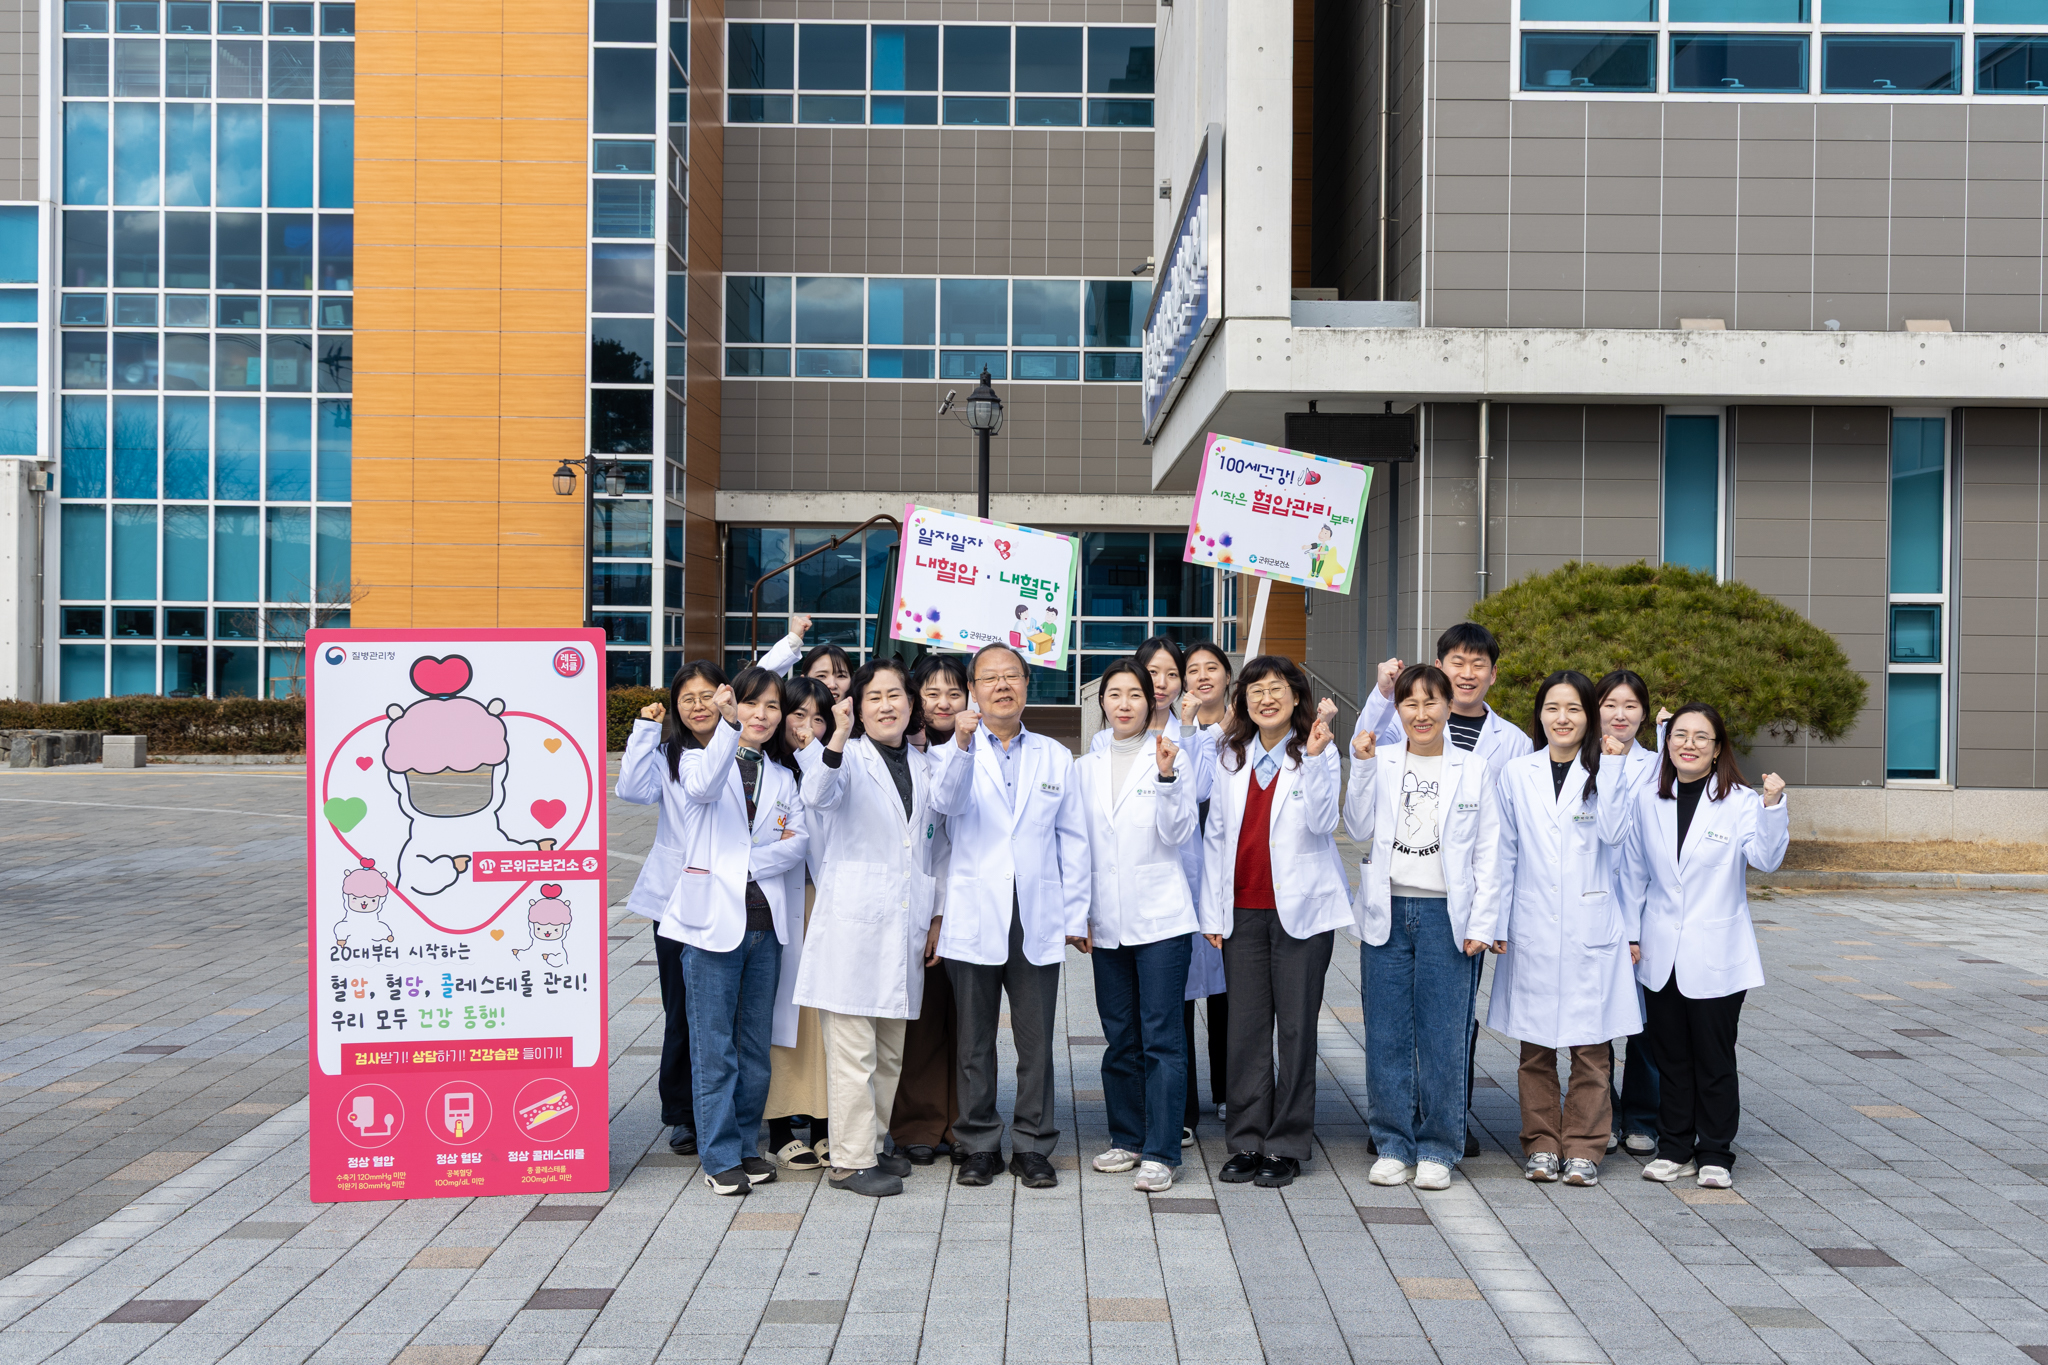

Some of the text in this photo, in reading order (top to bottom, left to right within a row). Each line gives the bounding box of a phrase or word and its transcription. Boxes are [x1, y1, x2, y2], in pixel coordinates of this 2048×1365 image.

[1220, 455, 1295, 485] 100세건강!
[1211, 489, 1248, 506] 시작은
[918, 528, 983, 552] 알자알자
[1258, 556, 1290, 569] 군위군보건소
[916, 555, 979, 586] 내혈압
[1000, 571, 1060, 602] 내혈당
[351, 651, 396, 661] 질병관리청
[560, 653, 578, 662] 레드
[560, 662, 578, 671] 서클
[500, 858, 579, 872] 군위군보건소
[330, 943, 471, 962] 20대부터 시작하는
[331, 970, 588, 1002] 혈압, 혈당, 콜레스테롤 관리!
[331, 1005, 506, 1032] 우리 모두 건강 동행!
[355, 1047, 563, 1065] 검사받기! 상담하기! 건강습관 들이기!
[347, 1155, 395, 1168] 정상 혈압
[436, 1152, 483, 1165] 정상 혈당
[508, 1148, 585, 1162] 정상 콜레스테롤
[357, 1173, 392, 1182] 120mmHg
[393, 1171, 406, 1180] 미만
[446, 1169, 473, 1178] 공복혈당
[521, 1174, 572, 1184] 200mg/dL 미만
[358, 1182, 391, 1190] 80mmHg
[392, 1181, 405, 1189] 미만
[435, 1177, 485, 1187] 100mg/dL 미만
